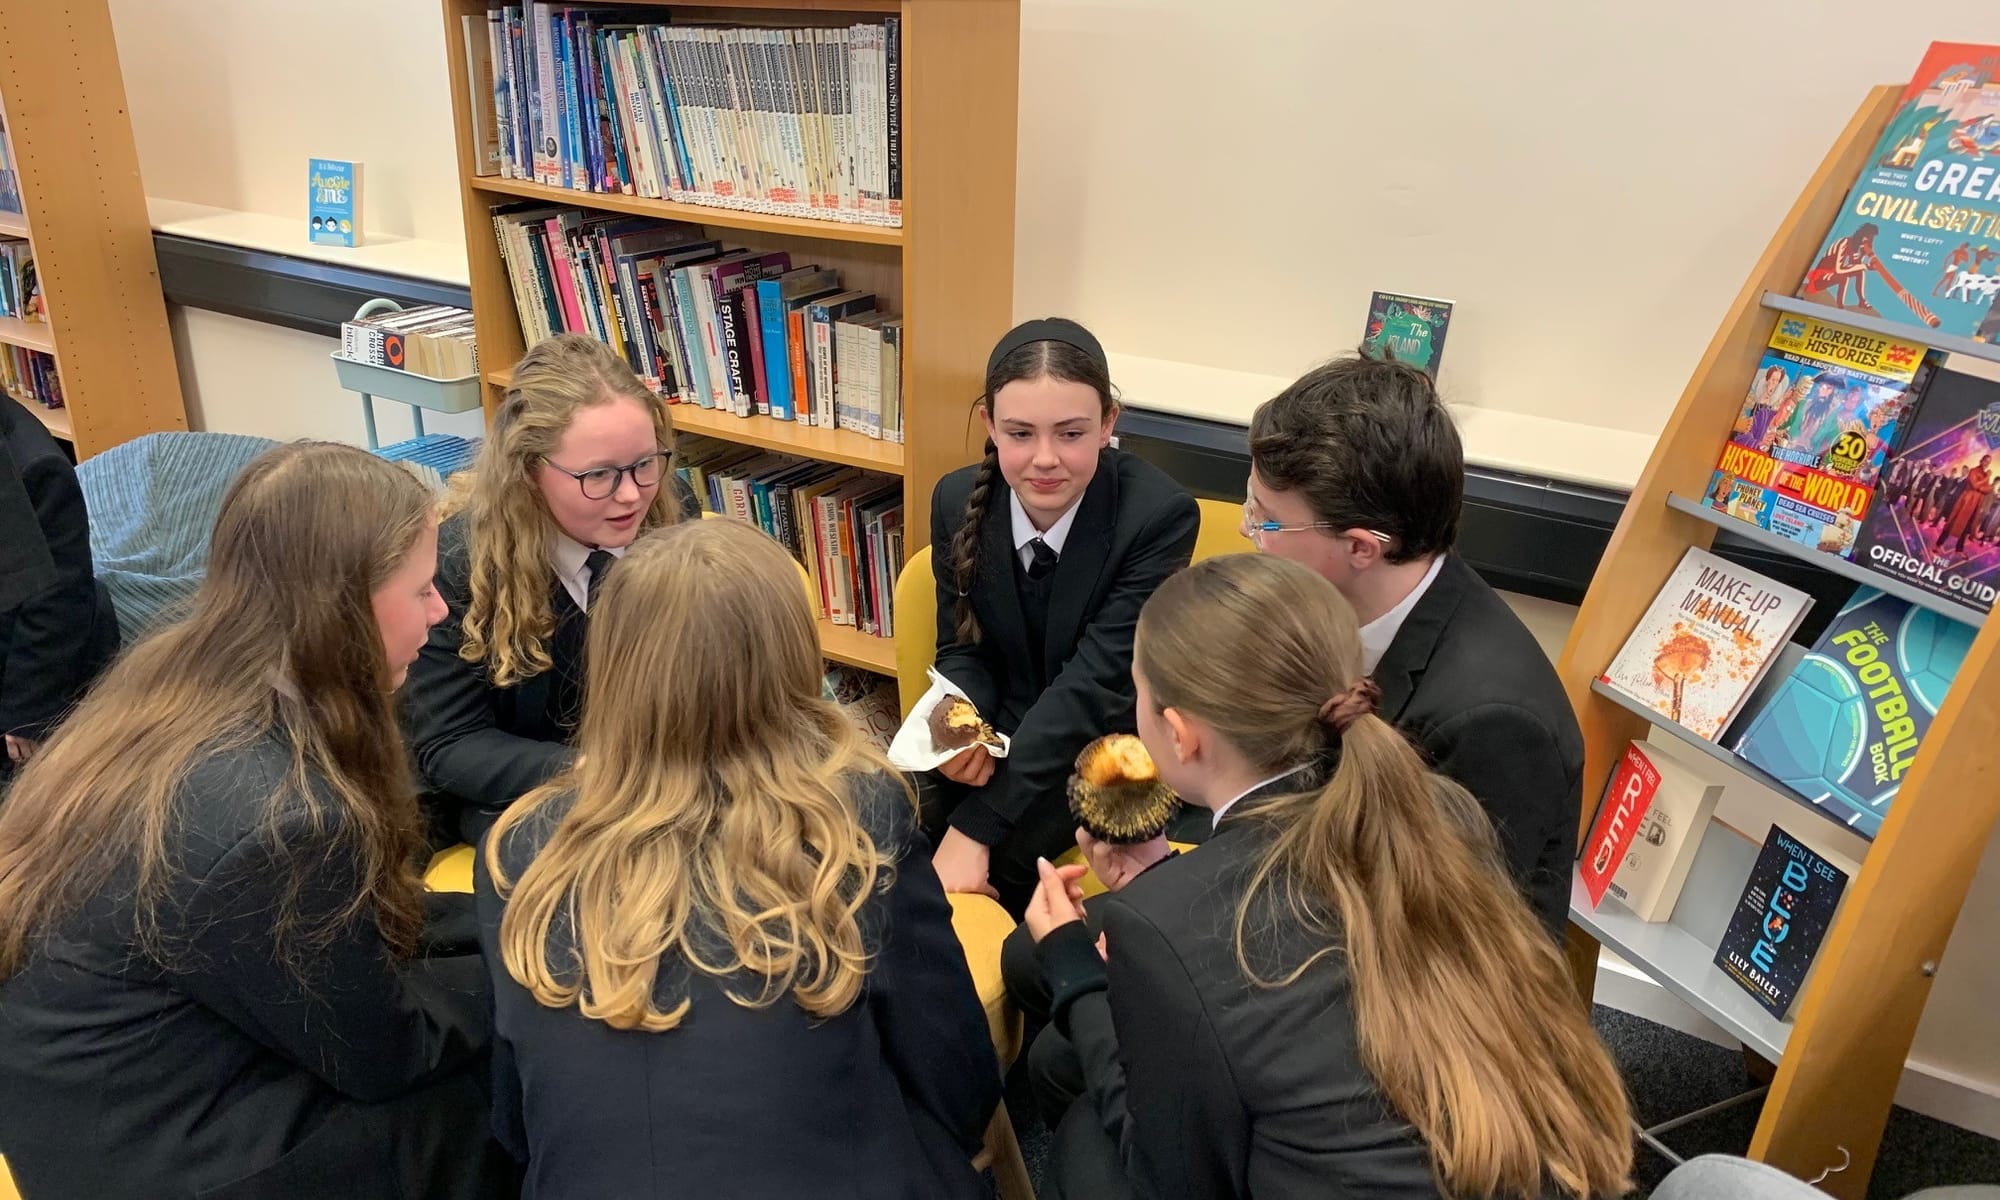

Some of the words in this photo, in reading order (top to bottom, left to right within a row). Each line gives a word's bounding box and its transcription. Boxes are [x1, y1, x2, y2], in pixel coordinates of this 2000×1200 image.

[889, 63, 897, 92] ROYAL
[630, 92, 639, 122] HISTORY
[634, 92, 644, 122] BRITISH
[889, 93, 898, 127] SILVER
[704, 110, 714, 141] ANCIENT
[711, 142, 720, 170] GREECE
[838, 117, 846, 156] ELEPHANT
[889, 128, 898, 165] JUBILEE
[1914, 160, 2000, 202] GREA
[1856, 192, 2000, 240] CIVILISATI
[528, 268, 542, 310] BEADWORK
[678, 276, 695, 336] INSURRECTION
[627, 286, 640, 322] TWENTIETH
[636, 324, 646, 352] CENTURY
[642, 354, 650, 378] FASHIO
[721, 306, 736, 348] STAGE
[1410, 322, 1428, 338] The
[1810, 326, 1887, 354] HORRIBLE
[1388, 335, 1420, 356] ISLAND
[1804, 338, 1880, 367] HISTORIES
[728, 348, 743, 399] CRAFTS
[1784, 352, 1799, 363] READ
[1800, 356, 1814, 366] ALL
[1812, 360, 1834, 373] ABOUT
[1847, 368, 1870, 381] NASTY
[1771, 446, 1784, 460] THE
[1786, 450, 1820, 468] HORRIBLE
[1835, 434, 1865, 460] 30
[1720, 445, 1784, 488] HISTORY
[1779, 472, 1789, 485] OF
[1789, 474, 1805, 490] THE
[1803, 472, 1866, 516] WORLD
[1735, 484, 1762, 498] PHONEY
[827, 502, 837, 522] SIMON
[1740, 492, 1766, 512] PLANET
[1778, 498, 1794, 510] DEAD
[1794, 502, 1807, 514] SEA
[1808, 506, 1835, 524] CRUISES
[780, 512, 788, 529] EARLY
[828, 523, 838, 556] WIESENTHAL
[1870, 545, 1943, 584] OFFICIAL
[1933, 555, 1950, 568] THE
[1695, 566, 1782, 616] MAKE-UP
[1680, 589, 1761, 642] MANUAL
[1864, 620, 1889, 646] THE
[1832, 630, 1918, 781] FOOTBALL
[1628, 750, 1643, 768] WHEN
[1645, 768, 1657, 788] FEEL
[1870, 742, 1890, 786] BOOK
[1594, 773, 1643, 875] RED
[1637, 816, 1666, 848] ED
[1652, 809, 1672, 827] FEEL
[1776, 833, 1808, 862] WHEN
[1806, 853, 1815, 868] I
[1814, 862, 1836, 883] SEE
[1750, 860, 1809, 974] BLUE
[1729, 950, 1750, 971] LILY
[1749, 968, 1780, 998] BAILEY
